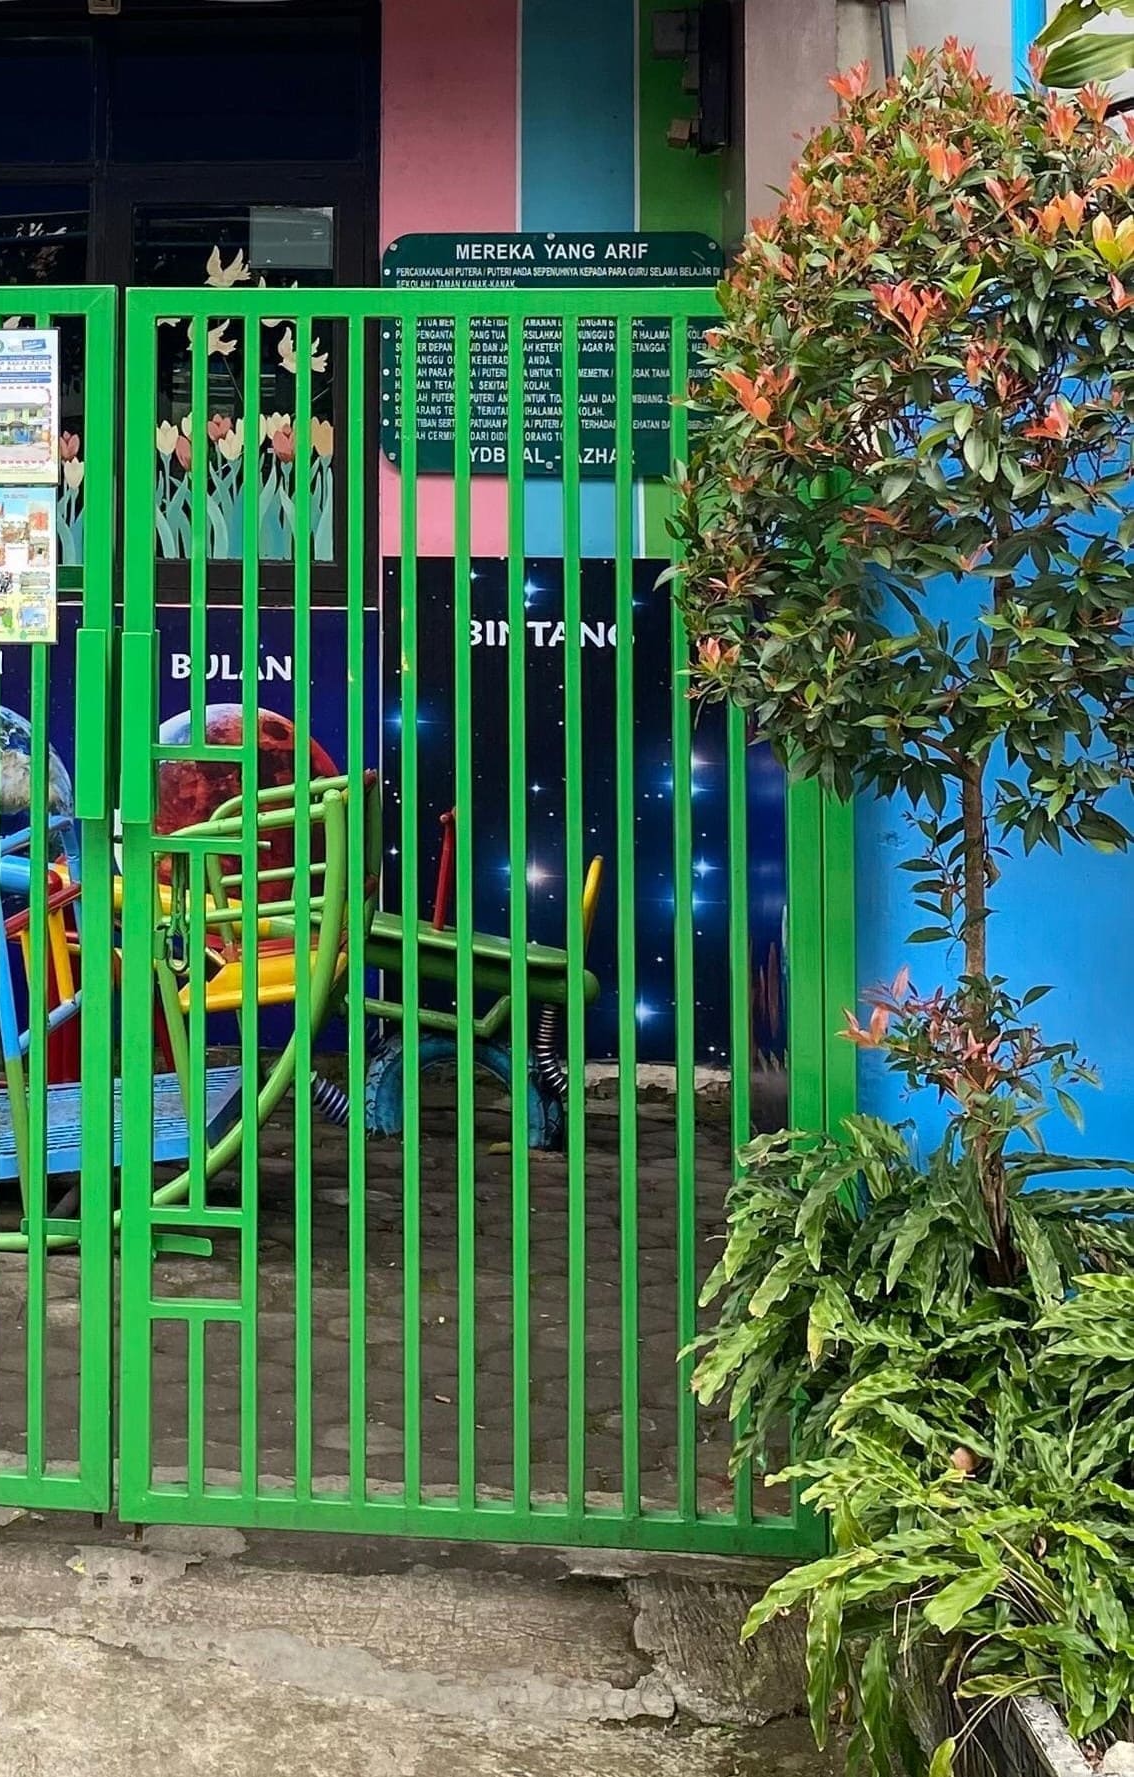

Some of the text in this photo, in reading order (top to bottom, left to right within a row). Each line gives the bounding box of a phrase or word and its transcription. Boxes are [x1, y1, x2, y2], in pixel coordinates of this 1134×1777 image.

[455, 243, 649, 260] MEREKA YANG ARIF
[395, 266, 455, 277] PERCAYAKANLAH
[455, 266, 482, 277] PUTERA
[487, 266, 512, 277] PUTERI
[512, 266, 532, 277] ANDA
[532, 266, 578, 277] SEPENUHNYA
[579, 266, 607, 277] KEPADA
[608, 266, 627, 277] PARA
[628, 266, 648, 277] GURU
[649, 266, 678, 277] SELAMA
[679, 266, 712, 277] BELAJAR
[396, 279, 430, 288] SEKOLAH
[436, 279, 460, 288] TAMAN
[438, 318, 481, 327] MENAH
[416, 330, 455, 340] PENGANTA
[469, 330, 490, 340] RANG
[491, 330, 506, 340] TUA
[639, 330, 671, 340] HALAMA
[428, 342, 453, 352] DEPAN
[482, 342, 498, 352] DAN
[499, 342, 534, 352] JAAH
[582, 342, 603, 352] AGAR
[394, 355, 445, 365] TANGGU
[428, 368, 448, 378] PARA
[482, 368, 507, 378] PUTERI
[528, 368, 553, 378] UNTUK
[478, 380, 508, 390] SEKITA
[523, 380, 552, 390] KOLAH.
[431, 393, 455, 403] PUTER
[469, 393, 495, 403] PUTERI
[524, 393, 547, 403] NTUK
[578, 393, 599, 403] AJAN
[394, 405, 442, 416] SARANG
[477, 405, 508, 416] TERUTA
[394, 418, 437, 428] KETIBAN
[437, 418, 455, 428] SERT
[469, 418, 502, 428] PATUHAN
[534, 418, 560, 428] PUTERI
[580, 418, 616, 428] TERHADA
[632, 418, 660, 428] EHATAN
[470, 431, 489, 441] DARI
[524, 431, 553, 441] ORANG
[469, 447, 506, 463] YDB
[522, 447, 546, 464] AL
[577, 447, 636, 465] ZHA
